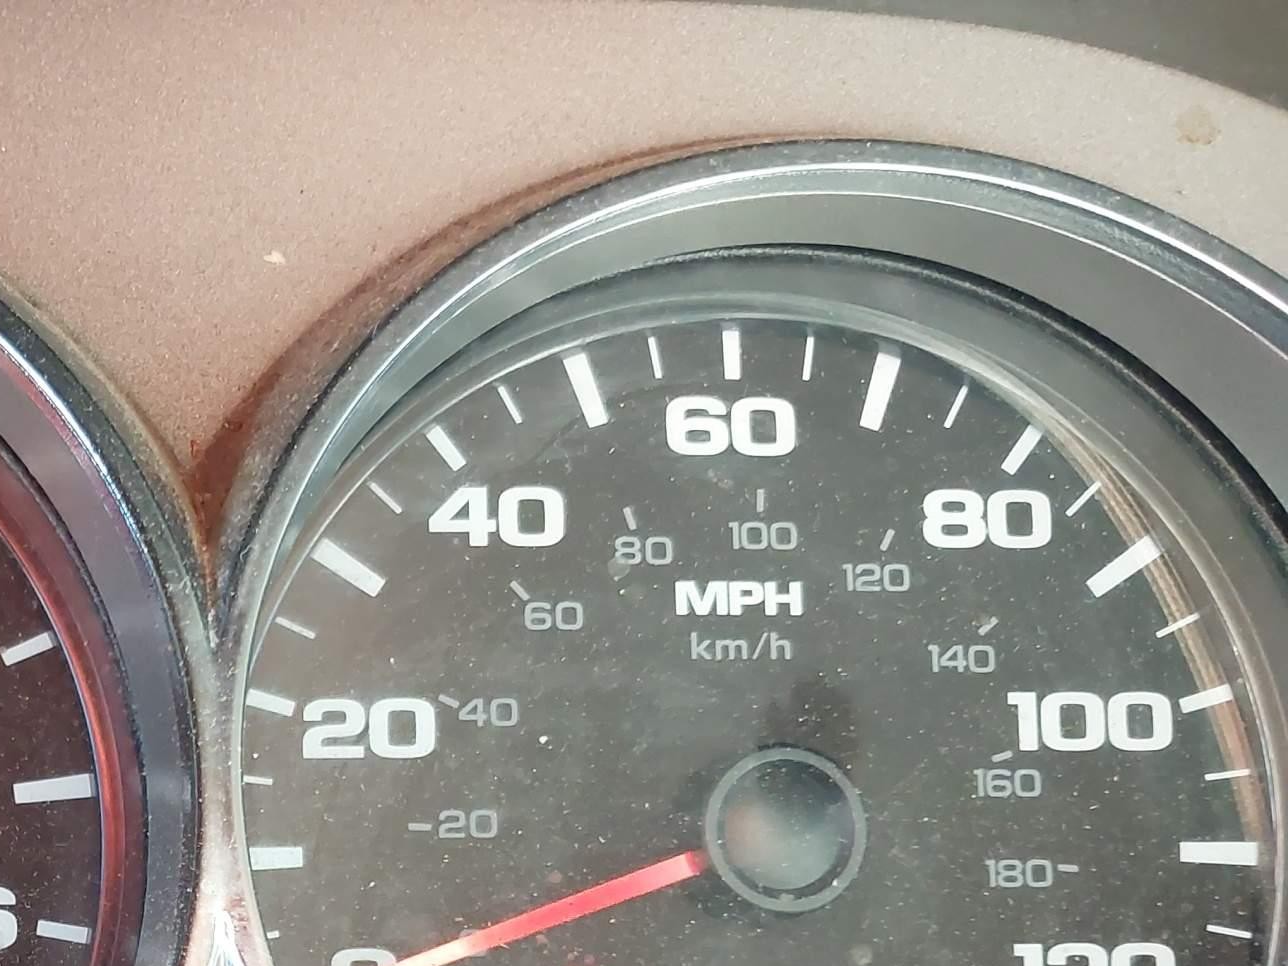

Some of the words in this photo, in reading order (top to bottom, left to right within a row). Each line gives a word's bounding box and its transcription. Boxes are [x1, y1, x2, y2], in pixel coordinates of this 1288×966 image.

[665, 395, 797, 457] 60
[428, 486, 567, 548] 40
[922, 488, 1052, 549] 80
[613, 536, 674, 566] 80
[728, 521, 799, 551] 100
[842, 563, 911, 593] 120
[674, 580, 804, 617] MPH
[523, 601, 585, 631] 60
[689, 632, 793, 662] km/h
[927, 644, 996, 674] 140
[457, 697, 519, 728] 40
[1006, 690, 1174, 752] 100
[301, 698, 437, 760] 20
[972, 767, 1043, 799] 160
[437, 809, 499, 840] 20
[984, 858, 1054, 889] 180
